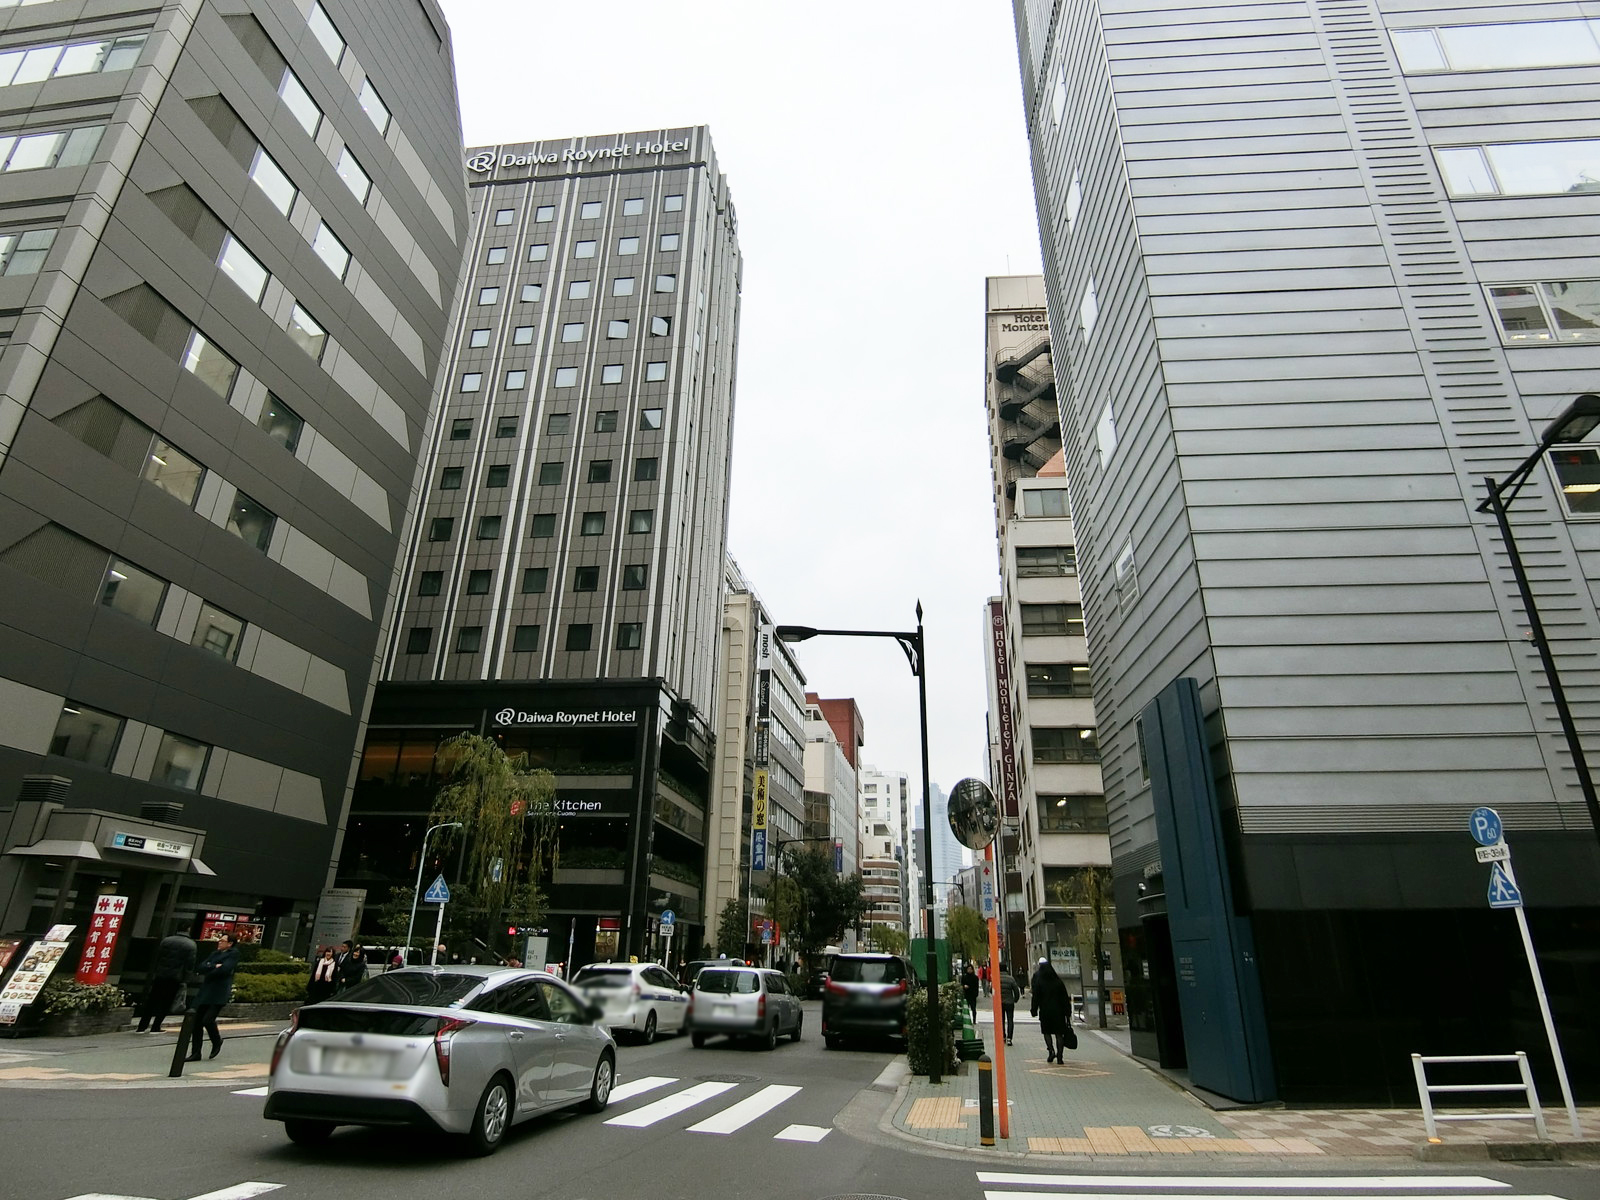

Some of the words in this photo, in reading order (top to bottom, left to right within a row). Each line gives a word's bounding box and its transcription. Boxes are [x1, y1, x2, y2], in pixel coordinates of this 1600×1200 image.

[501, 151, 558, 169] Daiwa
[562, 144, 630, 164] Roynet
[635, 137, 689, 155] Hotel
[1014, 313, 1046, 323] Hotel
[995, 630, 1005, 674] Hotel
[517, 711, 554, 723] Daiwa
[556, 711, 600, 725] Roynet
[602, 710, 636, 722] Hotel
[999, 679, 1011, 750] Monterey
[1004, 754, 1016, 801] GINZA
[554, 800, 602, 811] Kitchen
[1475, 817, 1488, 840] P
[1487, 828, 1497, 839] 60
[983, 881, 993, 911] 注意
[81, 916, 105, 974] 佐賀銀行
[96, 917, 120, 974] 佐賀銀行
